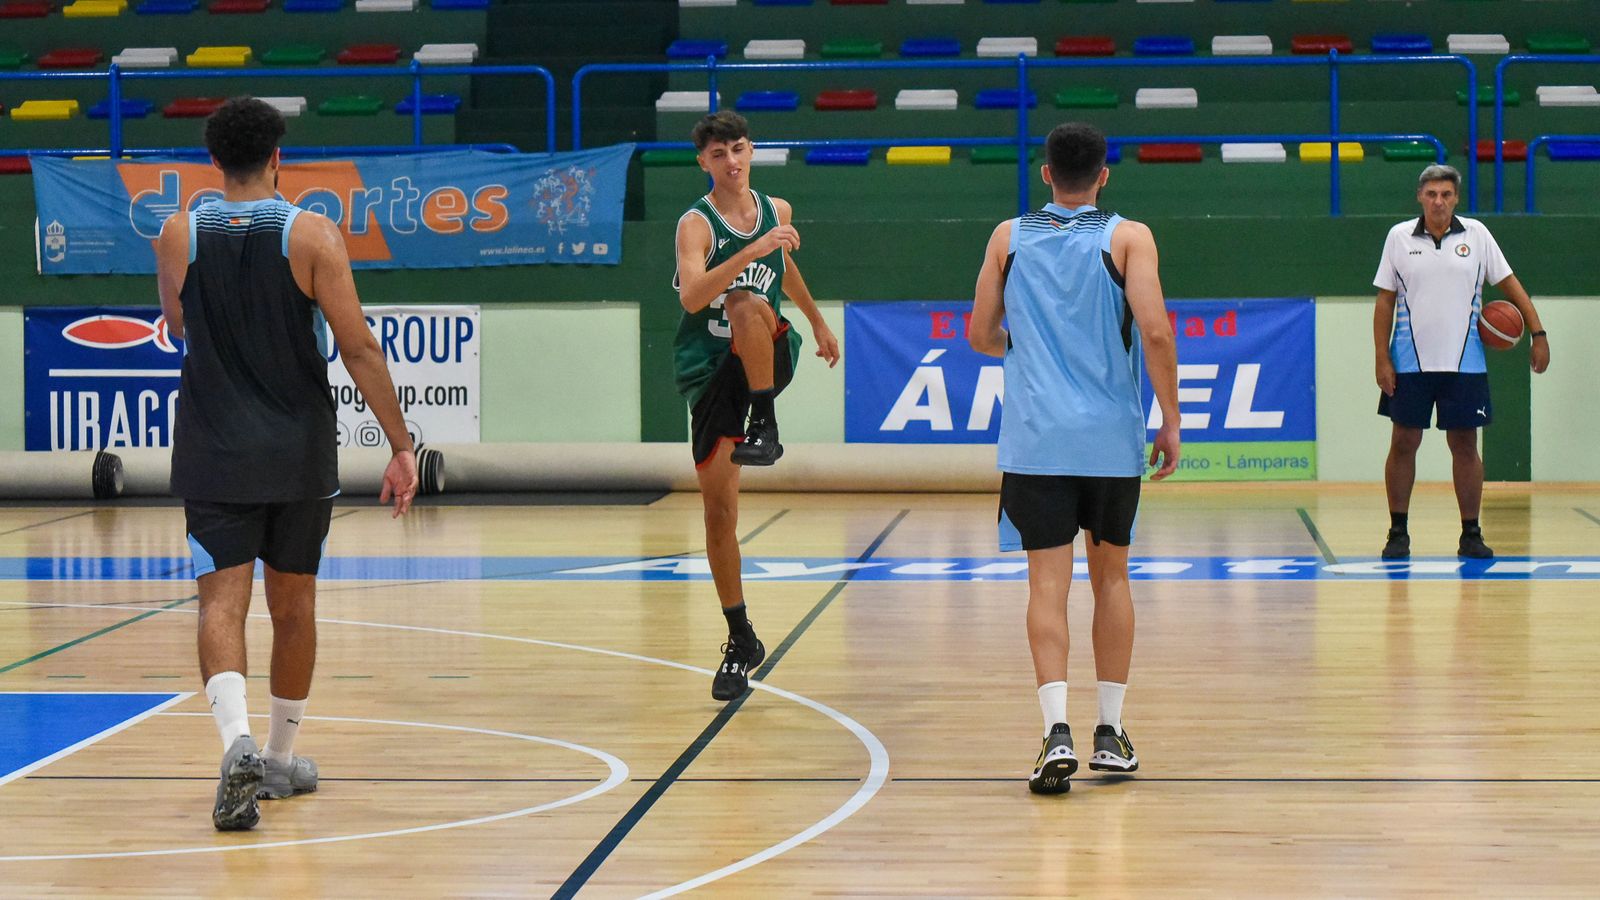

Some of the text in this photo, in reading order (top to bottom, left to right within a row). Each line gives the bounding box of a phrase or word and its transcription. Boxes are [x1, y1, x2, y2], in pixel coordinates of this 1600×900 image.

[130, 170, 509, 239] dortes
[728, 261, 777, 294] STON
[363, 315, 474, 364] ROUP
[879, 348, 1286, 432] ÁNEL
[1226, 454, 1310, 472] Lámparas
